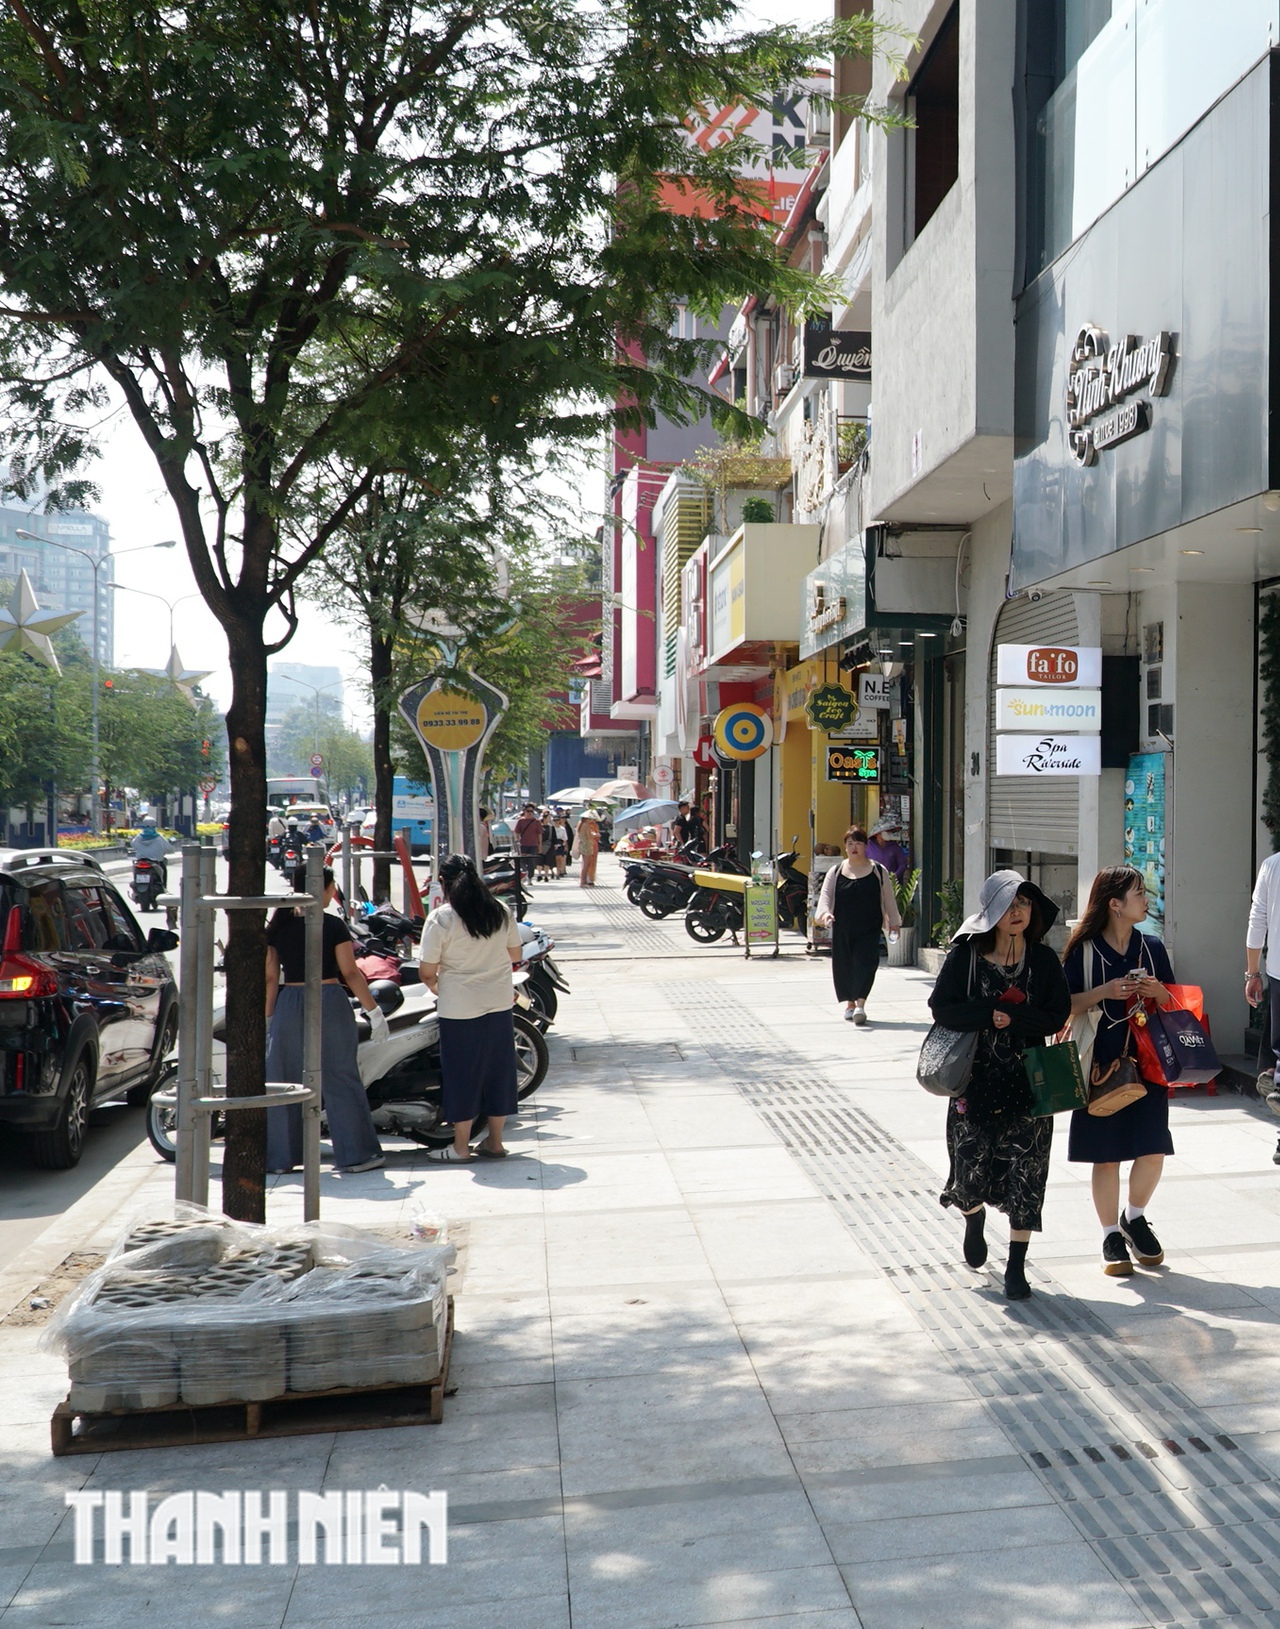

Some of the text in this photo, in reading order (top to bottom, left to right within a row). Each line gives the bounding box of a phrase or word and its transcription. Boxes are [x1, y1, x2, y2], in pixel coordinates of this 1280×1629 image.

[1116, 404, 1137, 434] 1998
[1029, 651, 1077, 674] faifo
[818, 712, 845, 720] Craft
[1035, 738, 1068, 757] Spa
[1022, 754, 1082, 773] Riverside
